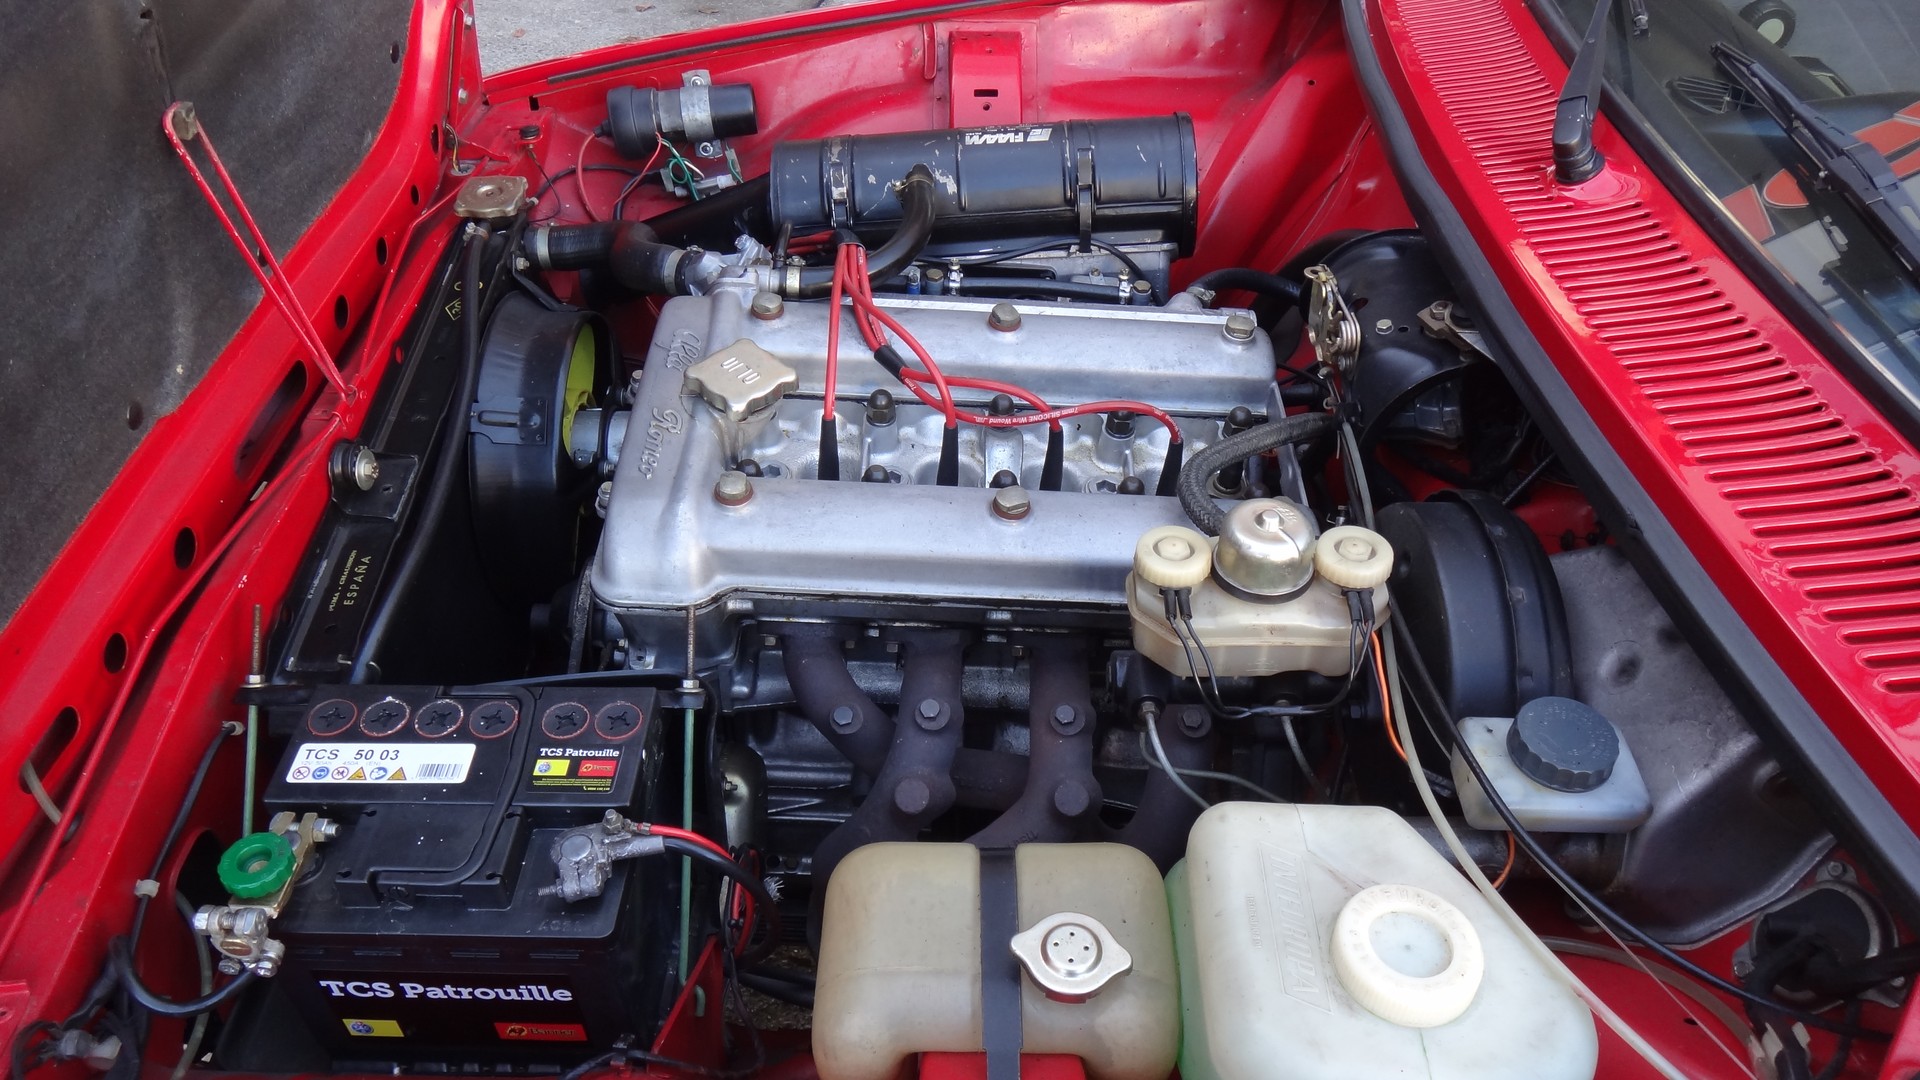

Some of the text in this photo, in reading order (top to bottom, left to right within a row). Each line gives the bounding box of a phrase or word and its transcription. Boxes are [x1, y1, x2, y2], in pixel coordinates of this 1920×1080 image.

[965, 132, 1024, 146] FIAAM
[720, 356, 761, 385] OLIO
[1028, 410, 1061, 423] SILICONE
[638, 407, 684, 480] Romeo
[343, 555, 372, 605] ESPAÑA
[304, 748, 400, 761] TCS 50 03
[539, 748, 620, 757] TCS Patrouille
[1269, 853, 1320, 994] INTEUROPA
[319, 980, 573, 1002] TCS Patrouille
